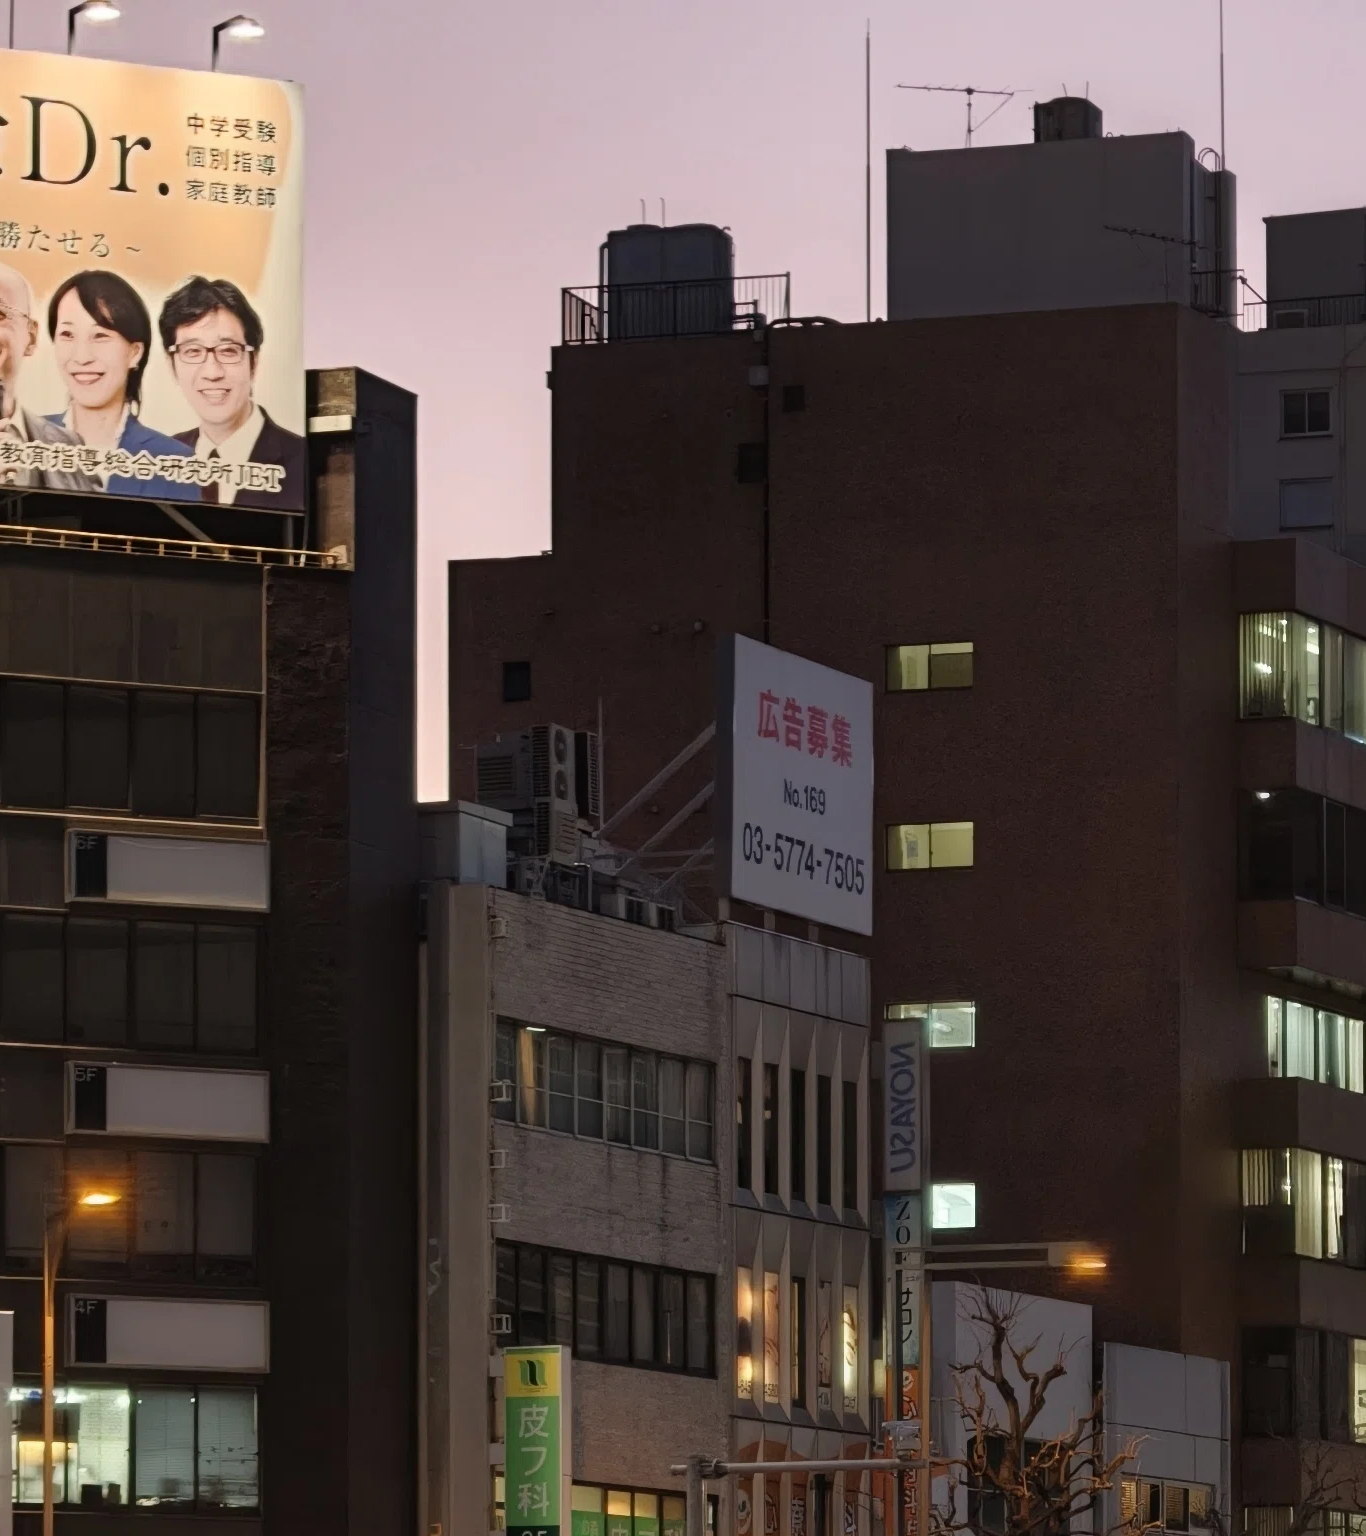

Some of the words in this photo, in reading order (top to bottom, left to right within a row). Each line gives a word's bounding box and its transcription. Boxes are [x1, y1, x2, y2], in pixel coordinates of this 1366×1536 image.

[187, 112, 276, 143] 中学受験
[185, 145, 276, 176] 個別指導
[185, 178, 276, 208] 家庭教師
[757, 689, 853, 769] 広告募集
[784, 778, 826, 815] No.169
[743, 822, 865, 895] 03-5774-7505
[518, 1403, 550, 1518] 皮フ科
